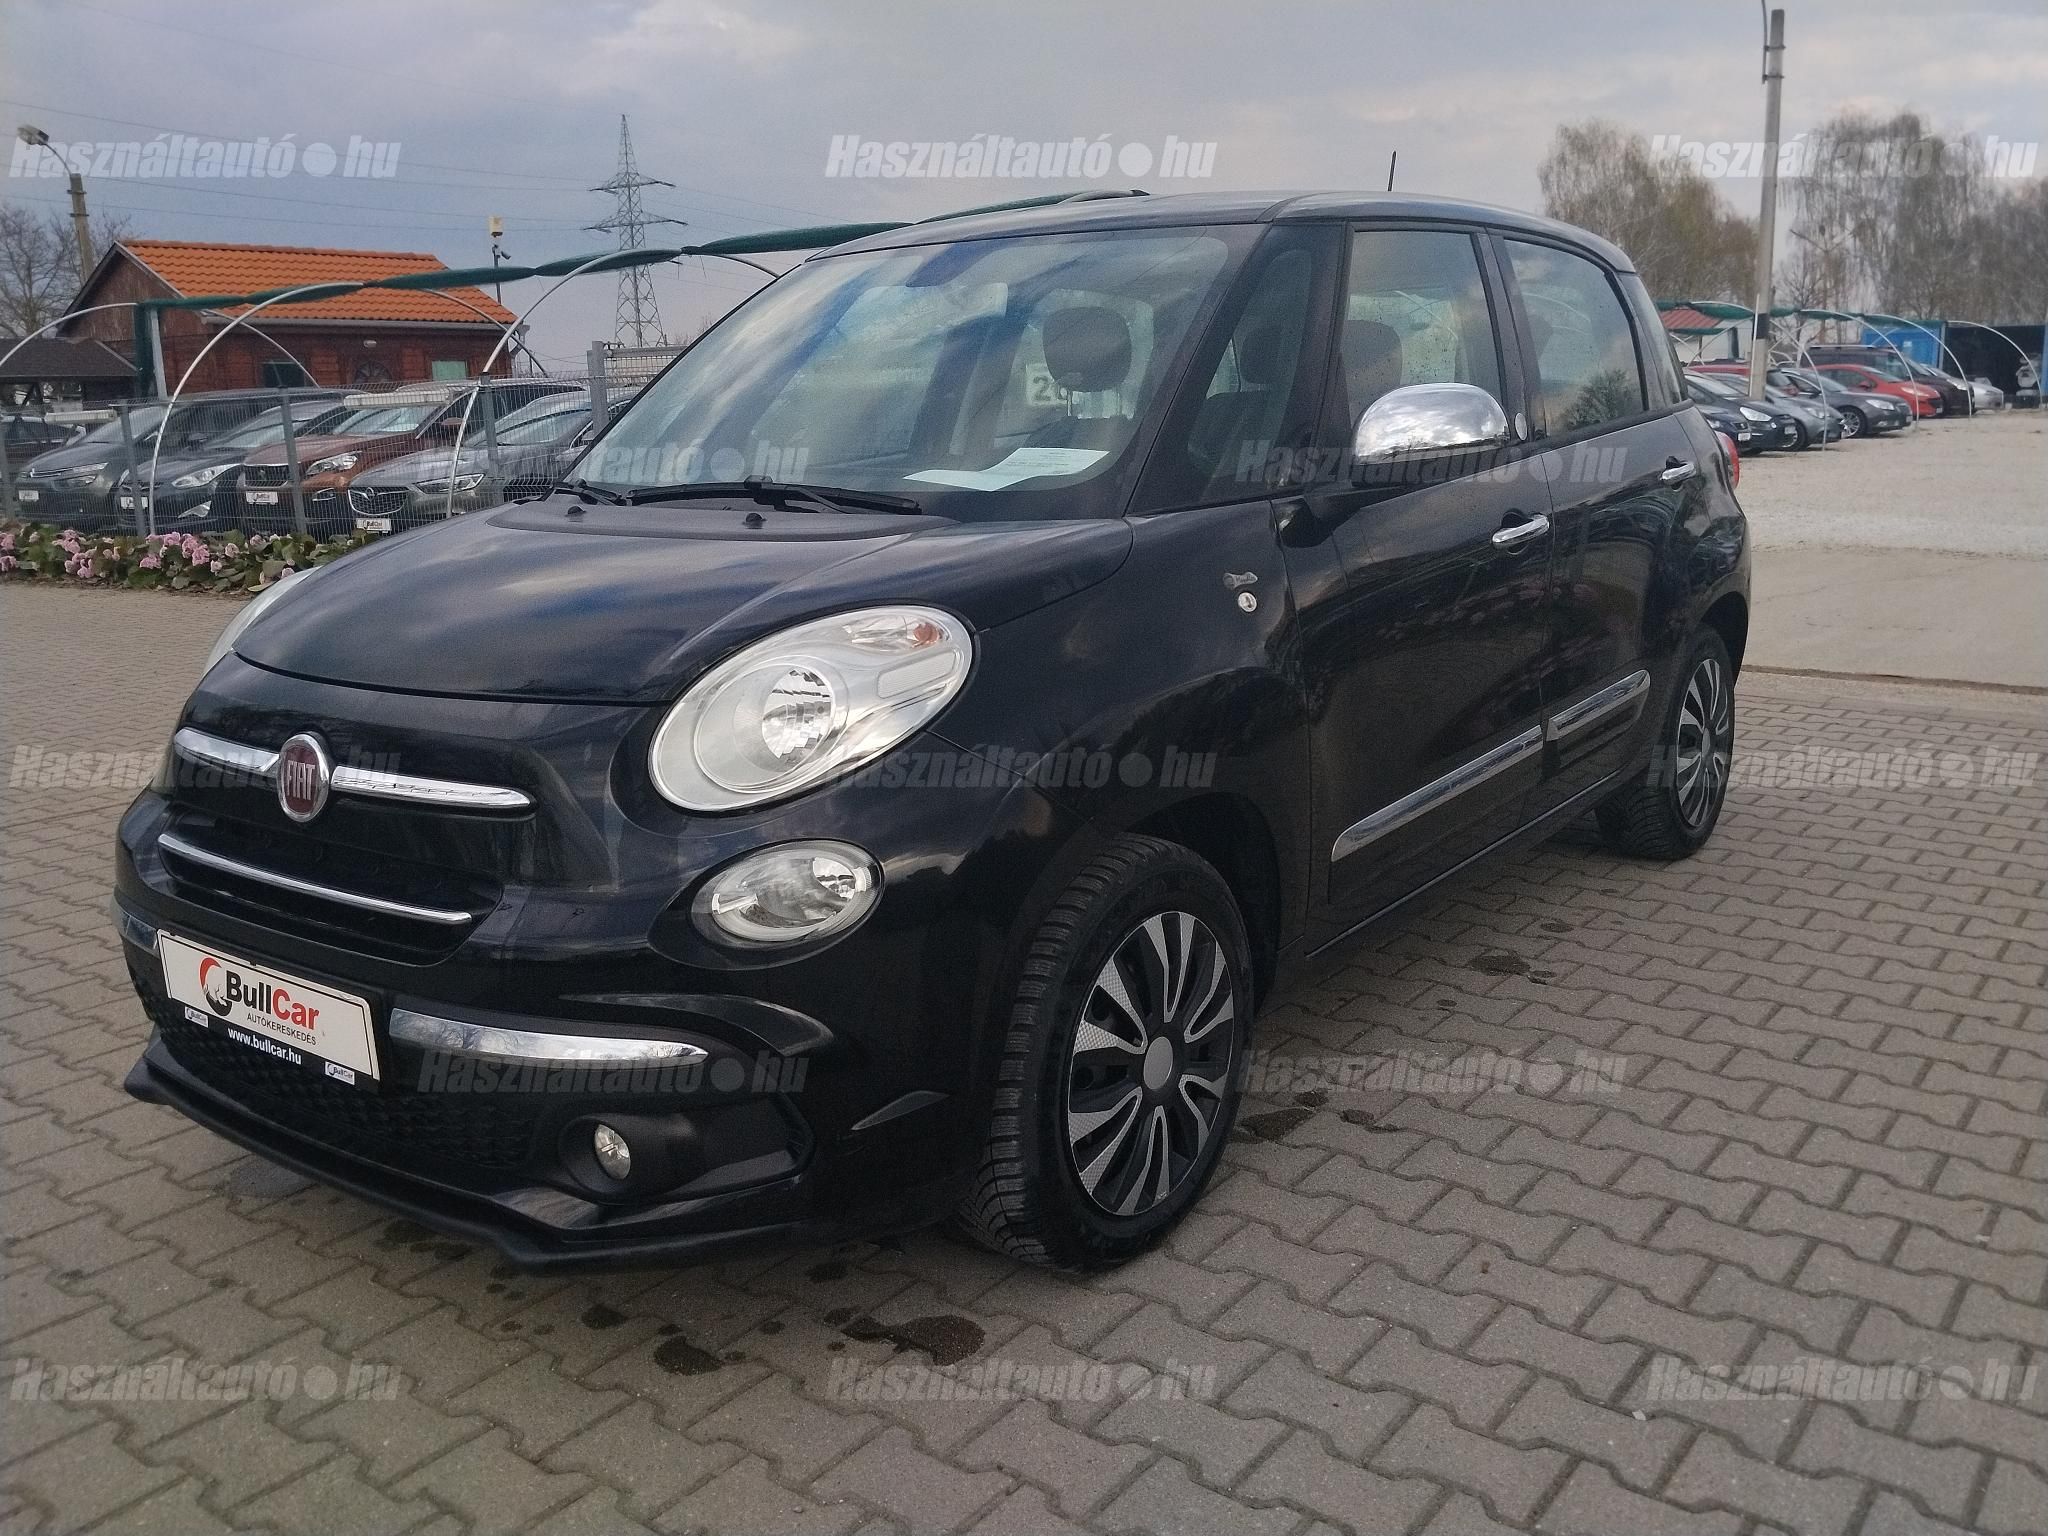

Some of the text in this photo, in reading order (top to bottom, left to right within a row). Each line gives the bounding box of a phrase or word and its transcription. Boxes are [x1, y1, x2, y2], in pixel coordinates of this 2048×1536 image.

[286, 760, 316, 801] FIAT
[226, 970, 320, 1031] BullCar
[228, 1027, 302, 1065] www.bullcar.hu
[247, 1012, 317, 1046] AUTÓKERESKEDÉS
